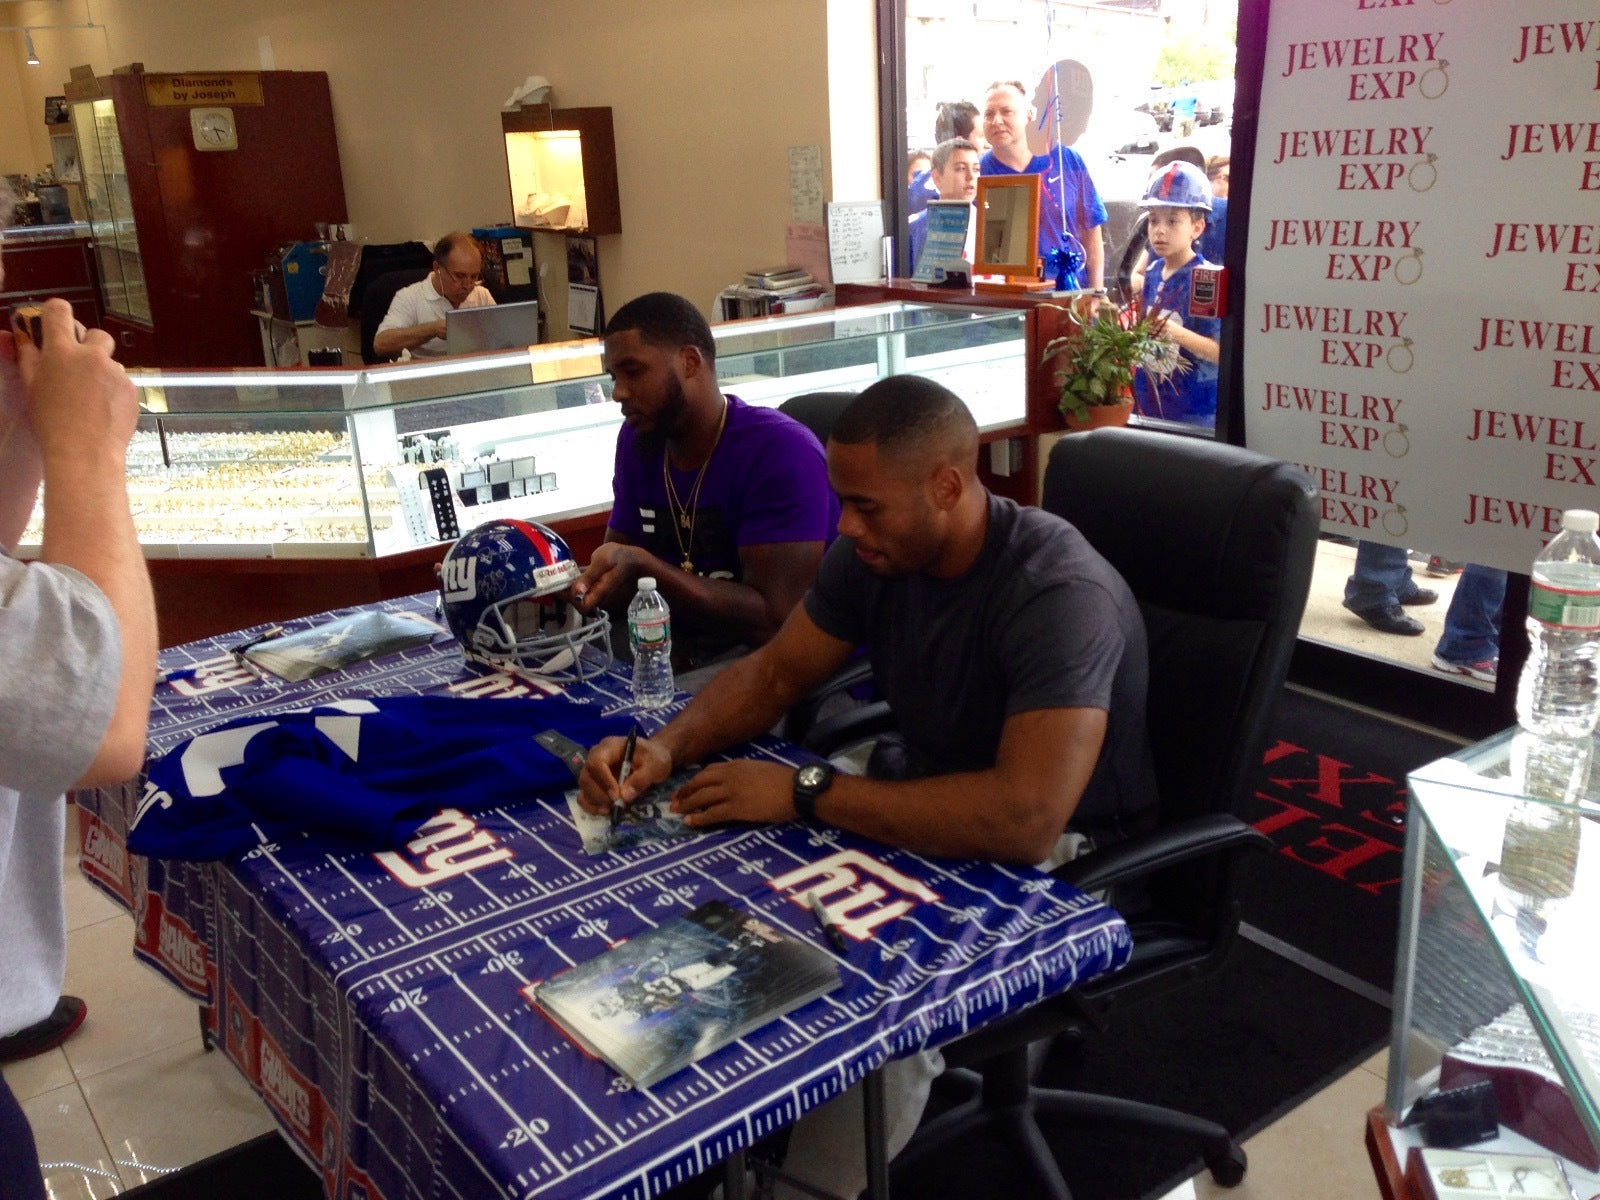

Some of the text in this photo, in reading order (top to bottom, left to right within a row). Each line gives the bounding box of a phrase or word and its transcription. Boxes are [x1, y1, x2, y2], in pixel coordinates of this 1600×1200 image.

[1282, 33, 1444, 77] JEWELRY
[1513, 21, 1600, 63] JEW
[171, 78, 233, 88] Diamonds
[173, 90, 236, 101] by Joseph
[1273, 127, 1433, 164] JEWELRY
[1264, 220, 1421, 251] JEWELRY
[1486, 223, 1600, 258] JEWE
[1194, 270, 1217, 282] FIRE
[1260, 304, 1408, 338] JEWELRY
[1262, 382, 1402, 423] JEWELRY
[1294, 463, 1399, 503] ELRY
[1464, 494, 1563, 534] JEWE
[612, 1076, 633, 1093] 3
[506, 1117, 549, 1148] 20
